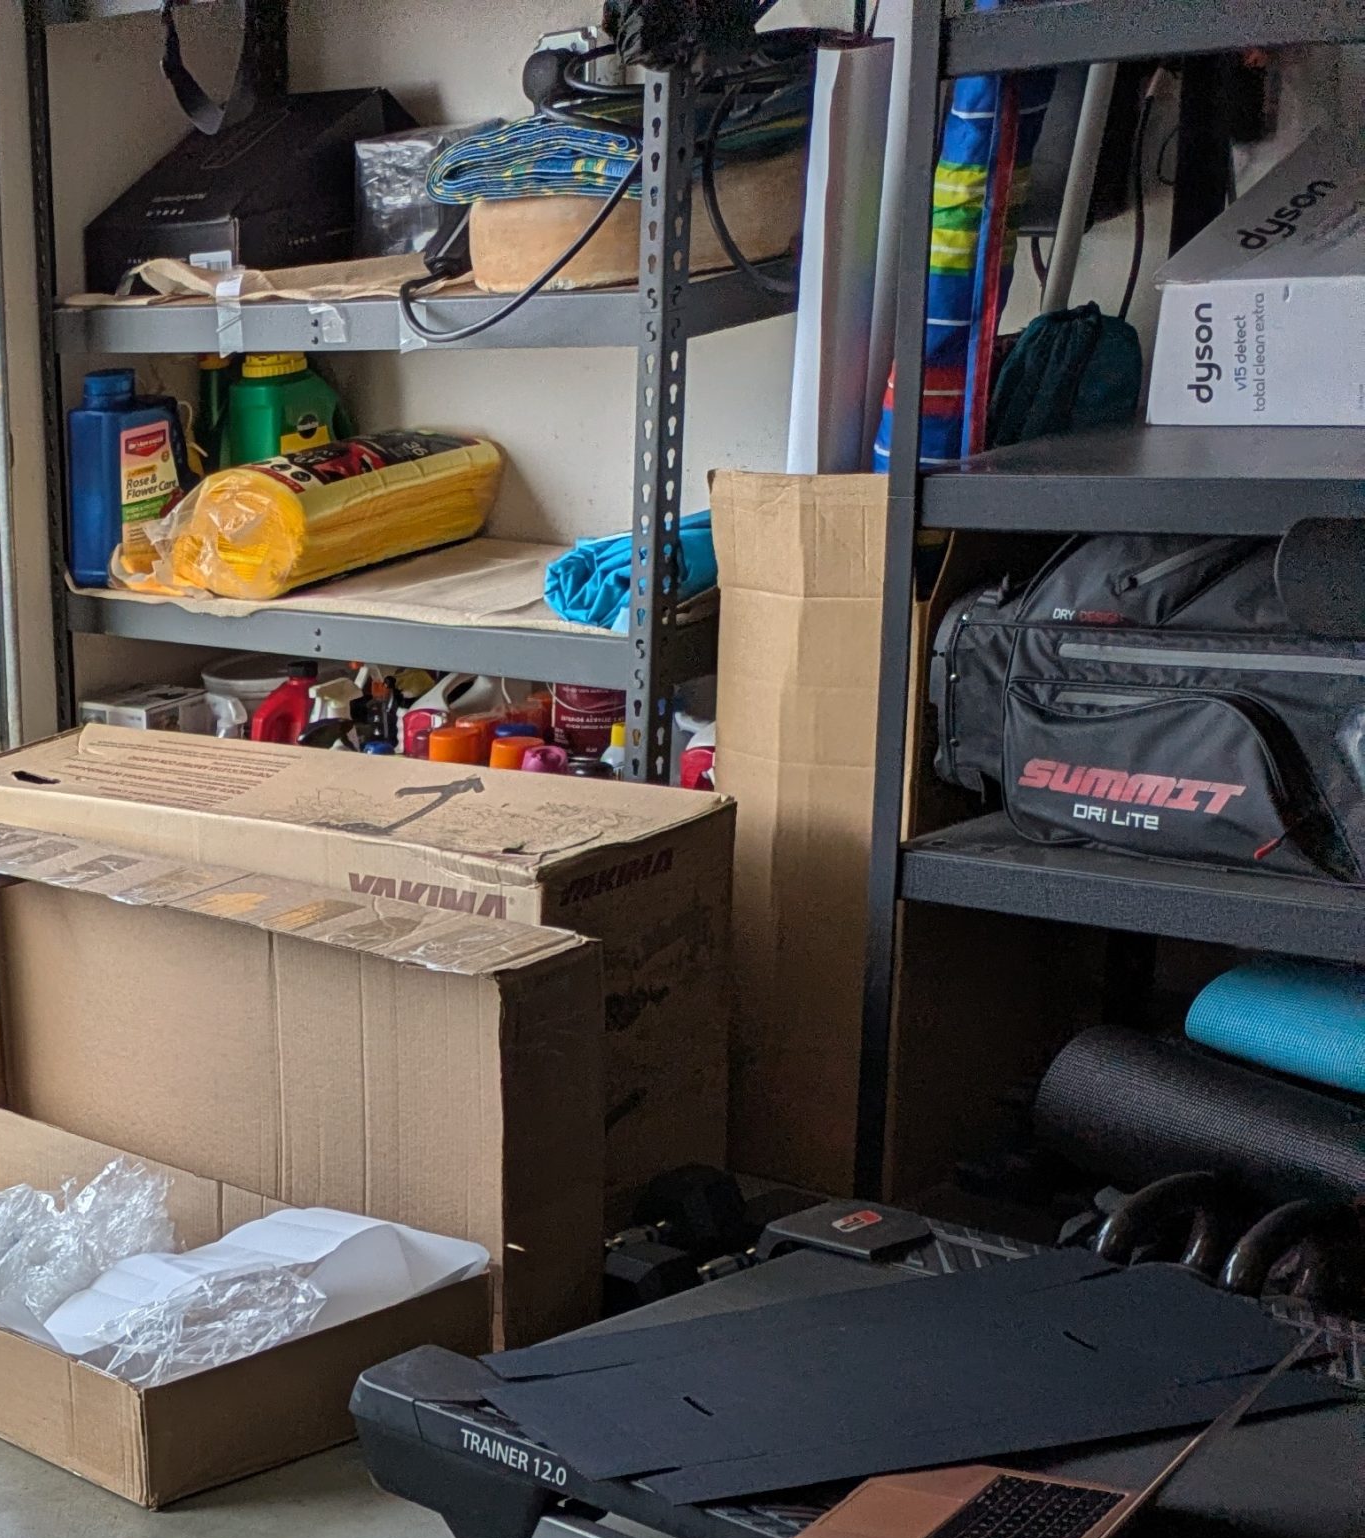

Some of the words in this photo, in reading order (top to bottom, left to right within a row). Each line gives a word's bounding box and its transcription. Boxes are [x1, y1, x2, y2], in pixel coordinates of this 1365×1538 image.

[1237, 179, 1336, 250] dyson
[1254, 292, 1266, 332] extra
[1187, 302, 1222, 404] dyson
[1234, 314, 1247, 363] detect
[1253, 336, 1266, 376] clean
[1234, 366, 1247, 391] v15
[1253, 379, 1266, 412] total
[125, 477, 149, 490] Rose
[125, 485, 158, 500] Flower
[158, 479, 177, 493] Care
[1052, 607, 1076, 621] DRY
[1019, 758, 1247, 815] SUMMIT
[348, 872, 507, 920] YAKIMA
[460, 1427, 529, 1473] TRAINER
[533, 1457, 568, 1487] 12.0
